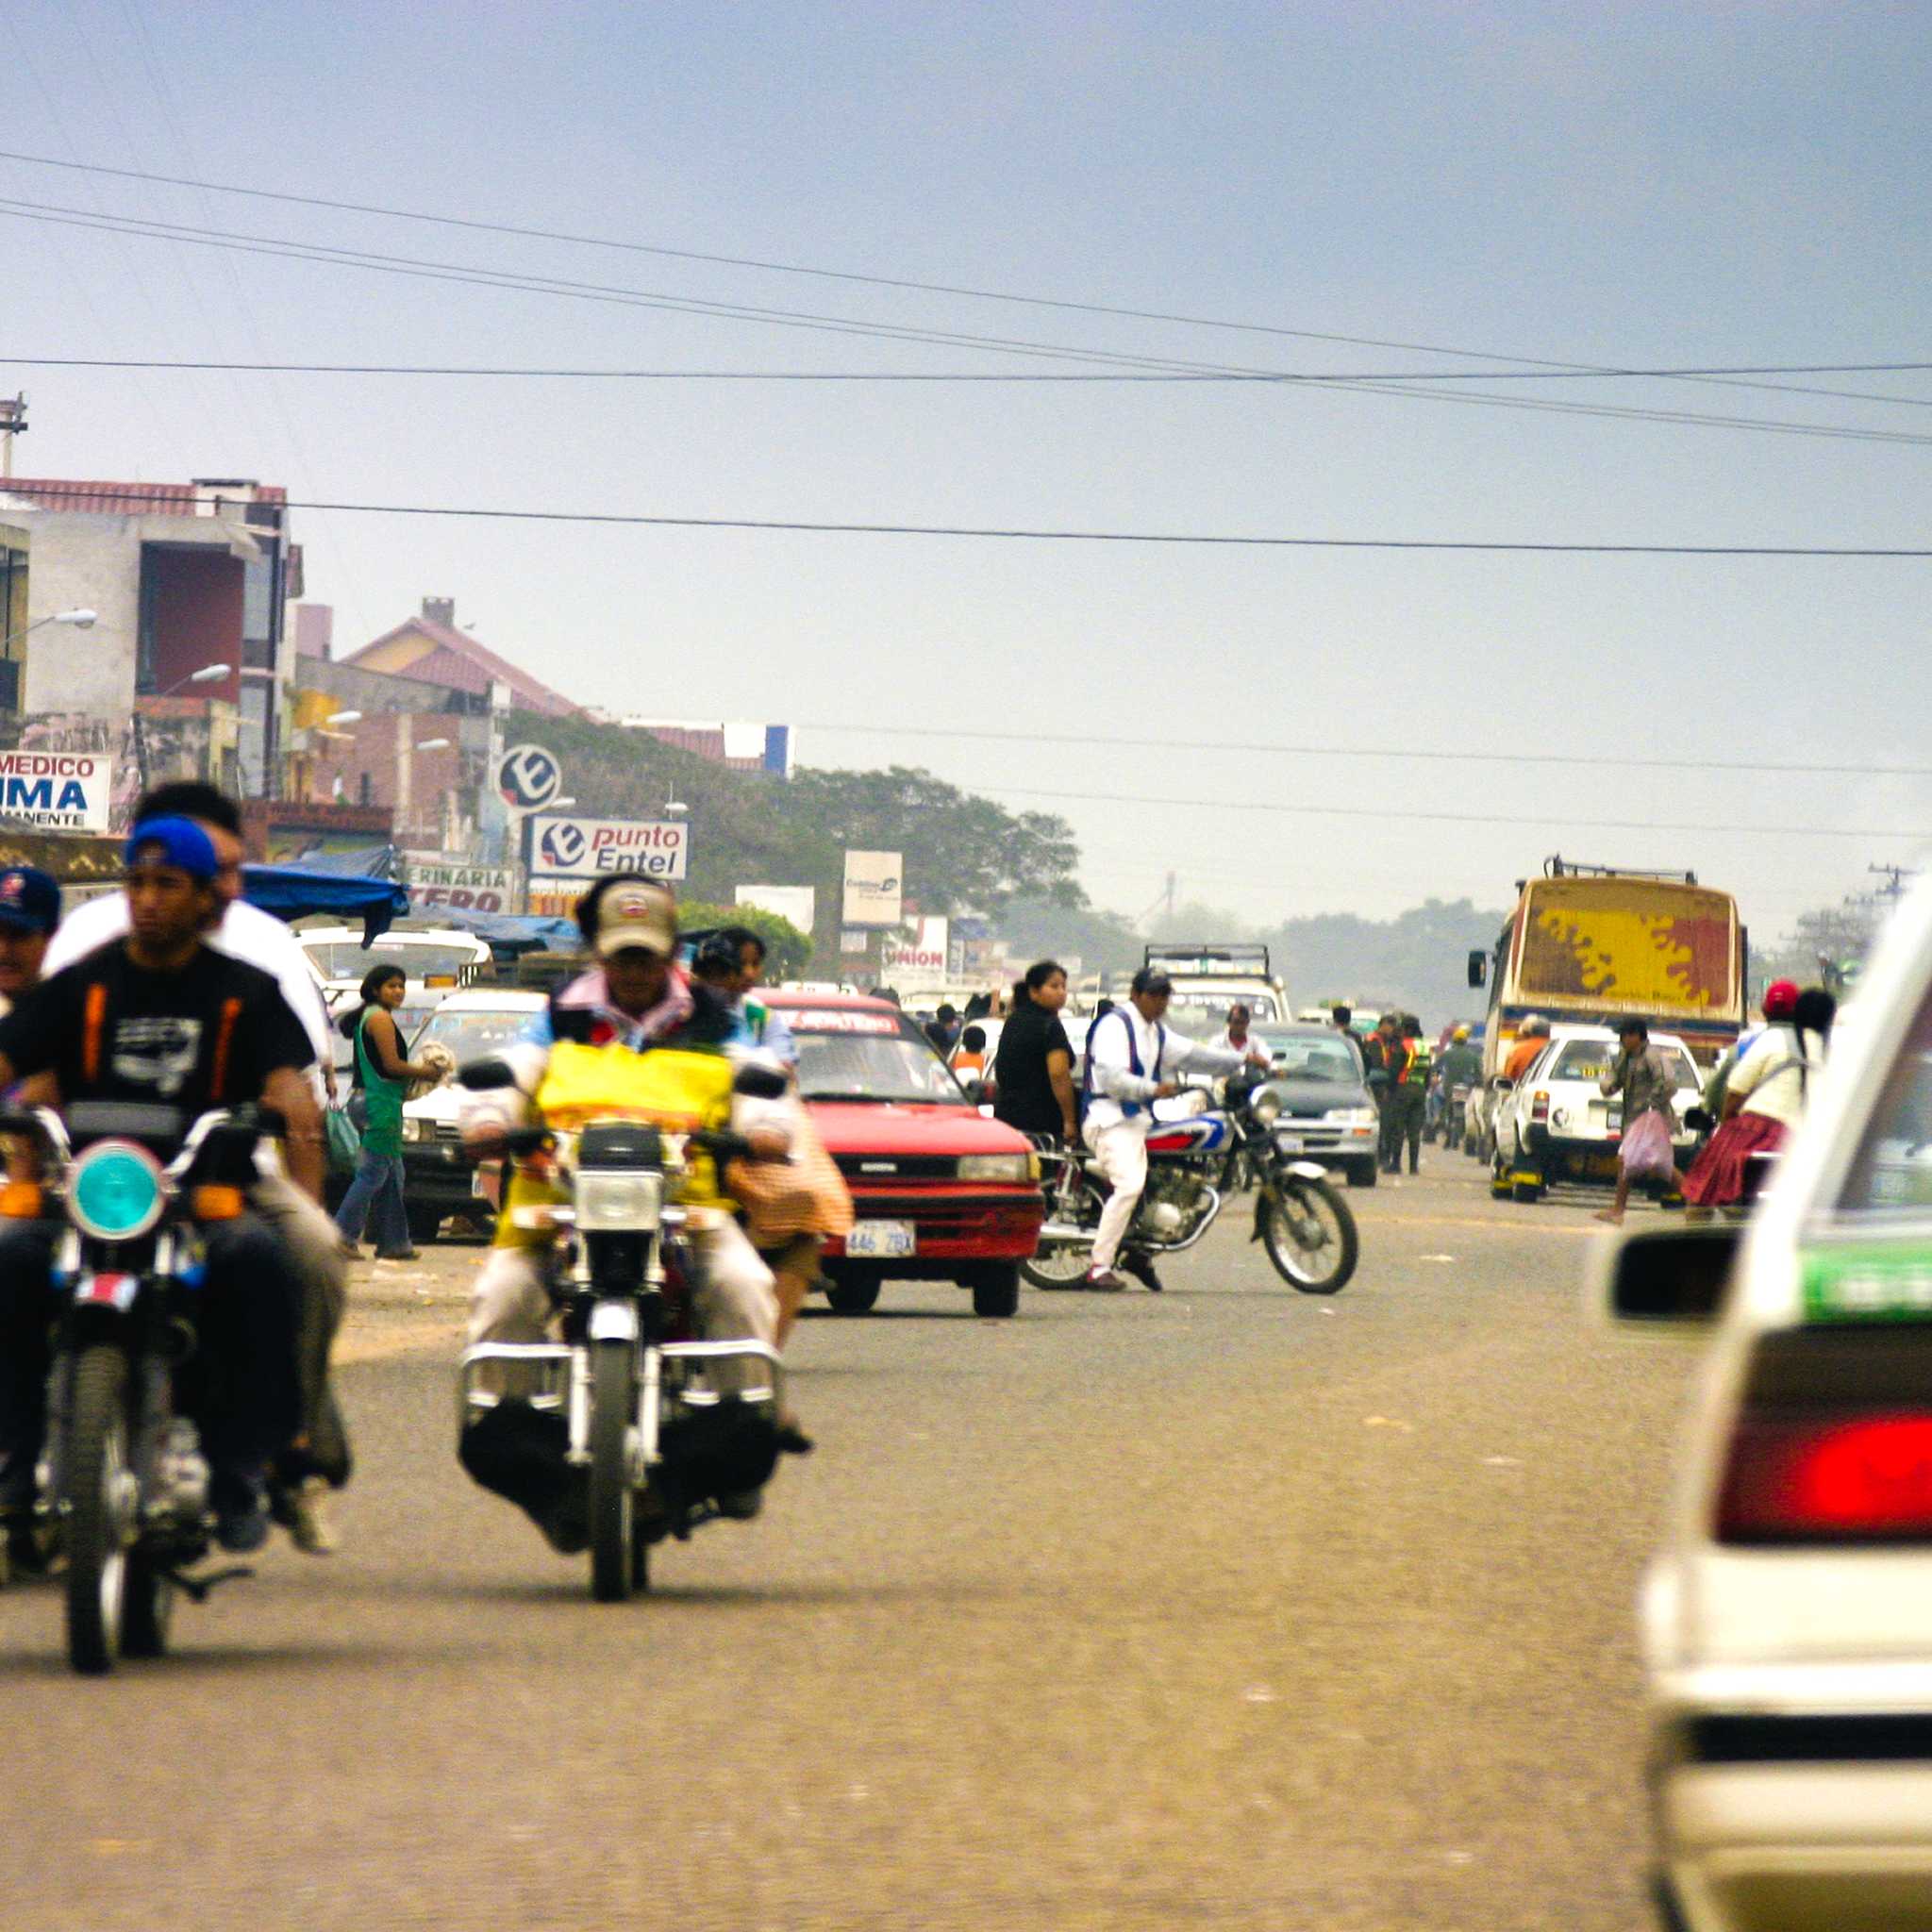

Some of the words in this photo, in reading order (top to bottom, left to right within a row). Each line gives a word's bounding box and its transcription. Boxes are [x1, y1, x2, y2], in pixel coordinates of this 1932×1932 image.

[0, 756, 93, 776] MEDICO
[591, 825, 680, 851] punto
[596, 848, 675, 874] Entel
